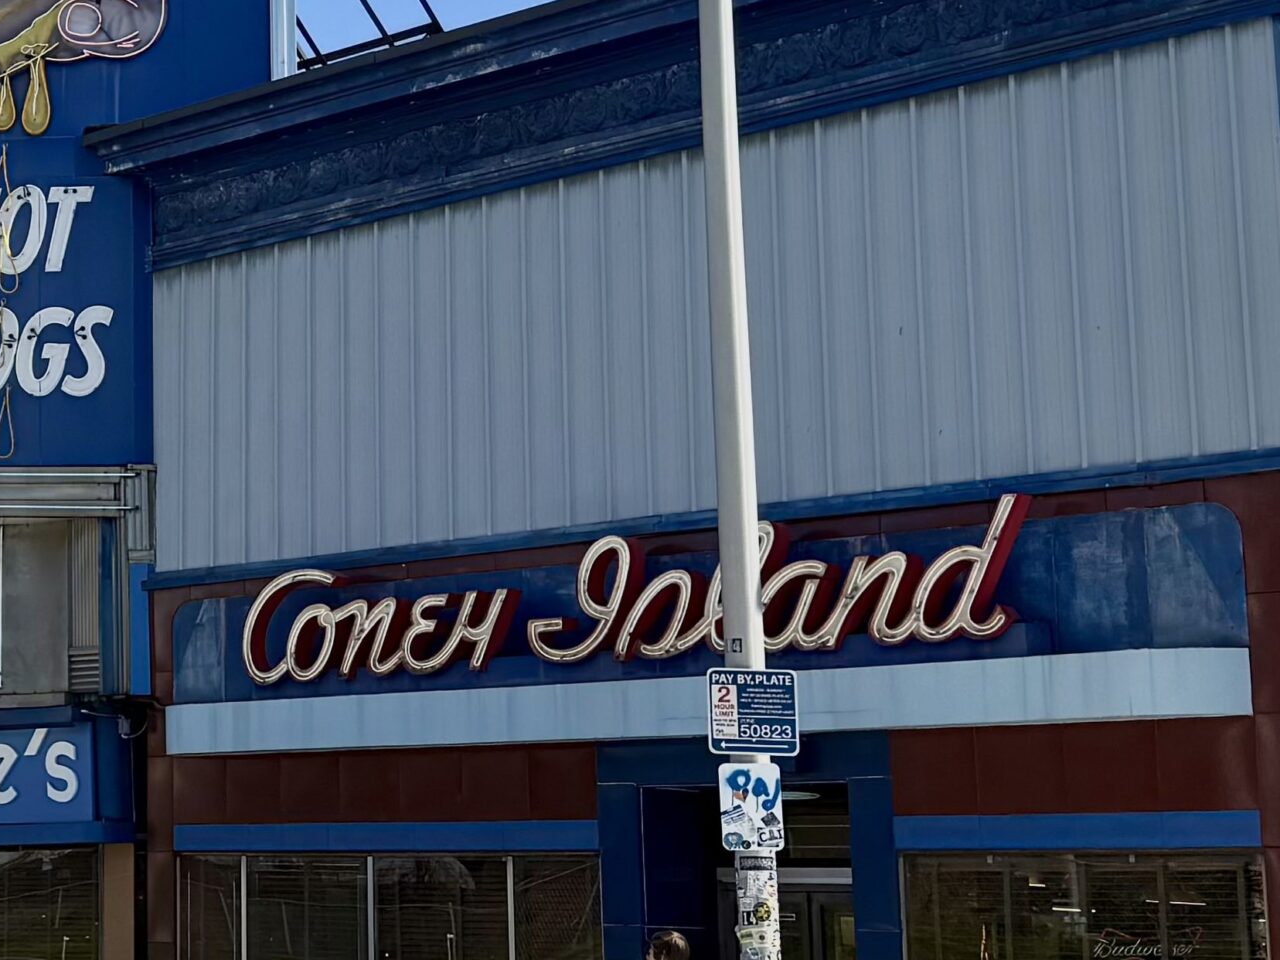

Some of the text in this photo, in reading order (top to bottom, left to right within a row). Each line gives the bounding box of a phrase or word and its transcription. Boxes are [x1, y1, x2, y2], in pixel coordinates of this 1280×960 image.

[711, 673, 792, 686] PAY BY PLATE
[718, 686, 731, 703] 2
[714, 710, 735, 718] LIMIT
[740, 724, 793, 739] 50823
[1093, 937, 1194, 959] Budweser
